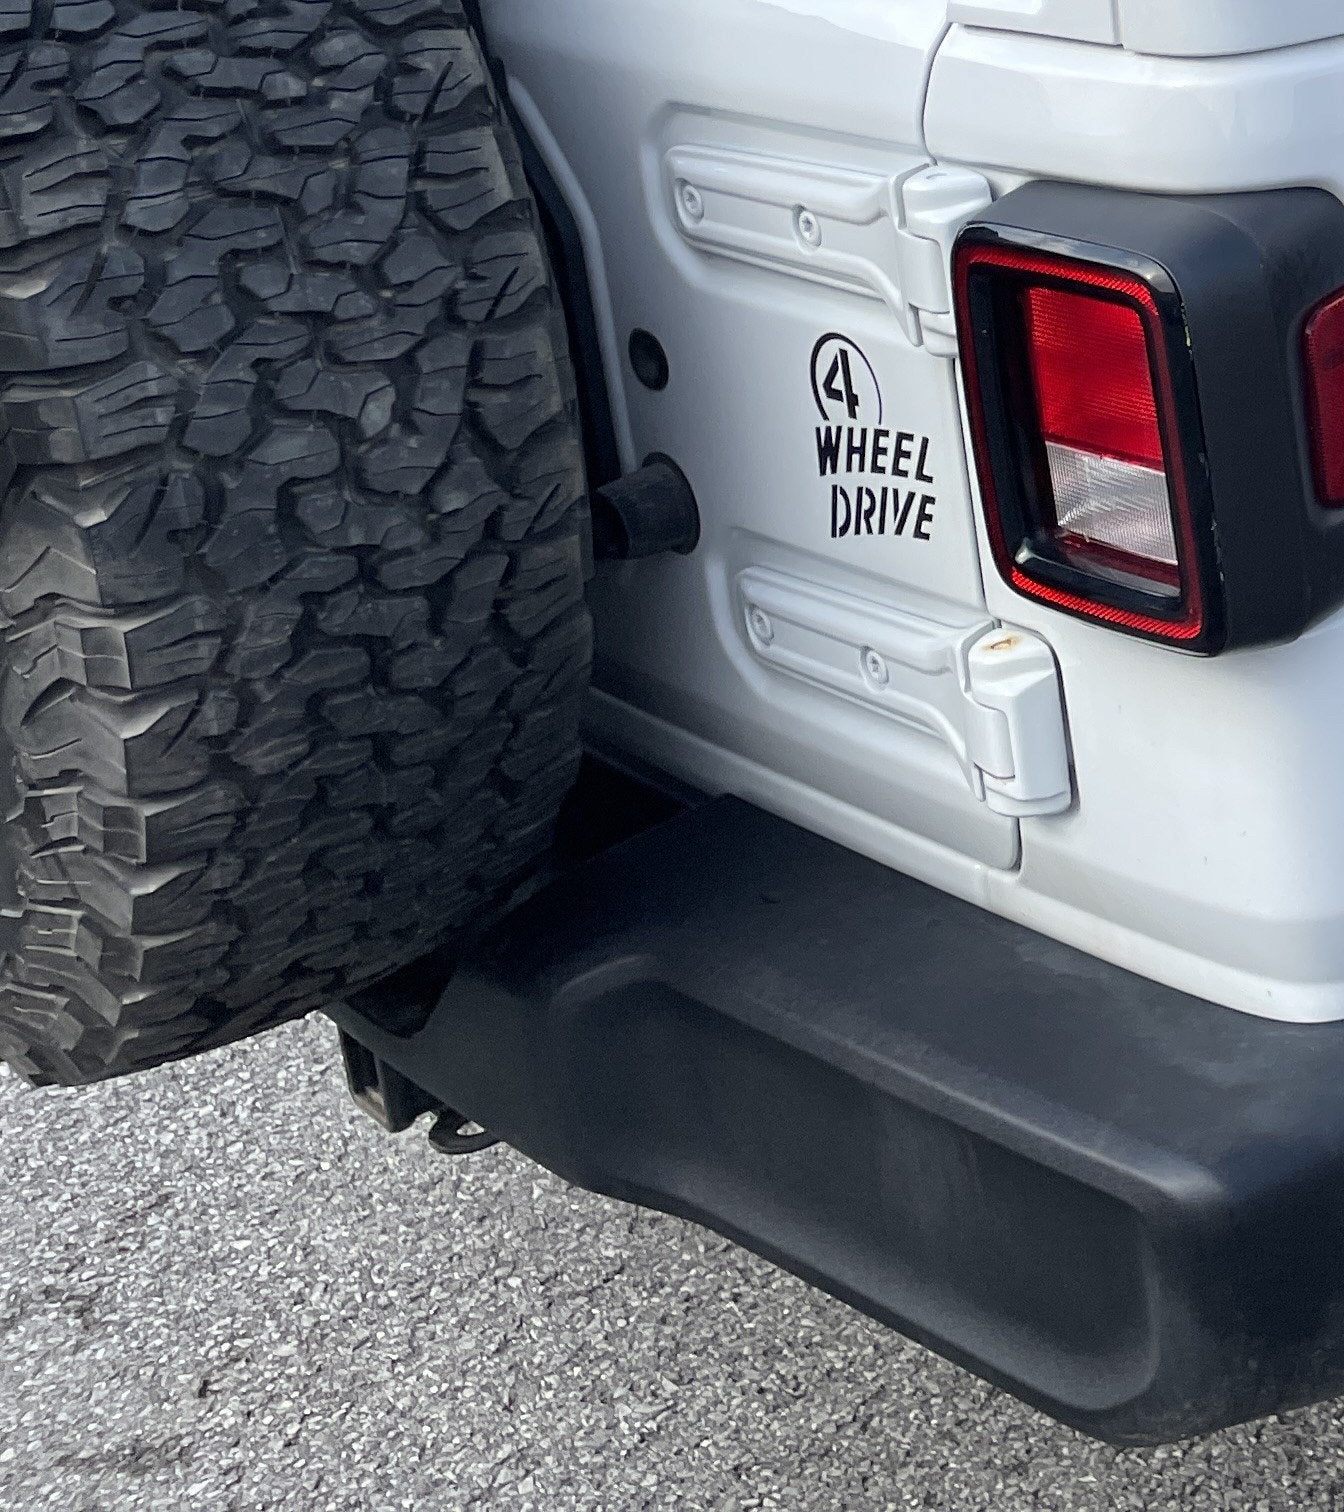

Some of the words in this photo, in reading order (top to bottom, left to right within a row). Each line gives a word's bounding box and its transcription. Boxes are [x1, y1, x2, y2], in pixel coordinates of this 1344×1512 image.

[822, 347, 860, 420] 4
[815, 425, 934, 484] WHEEL
[831, 484, 936, 541] DRIVE
